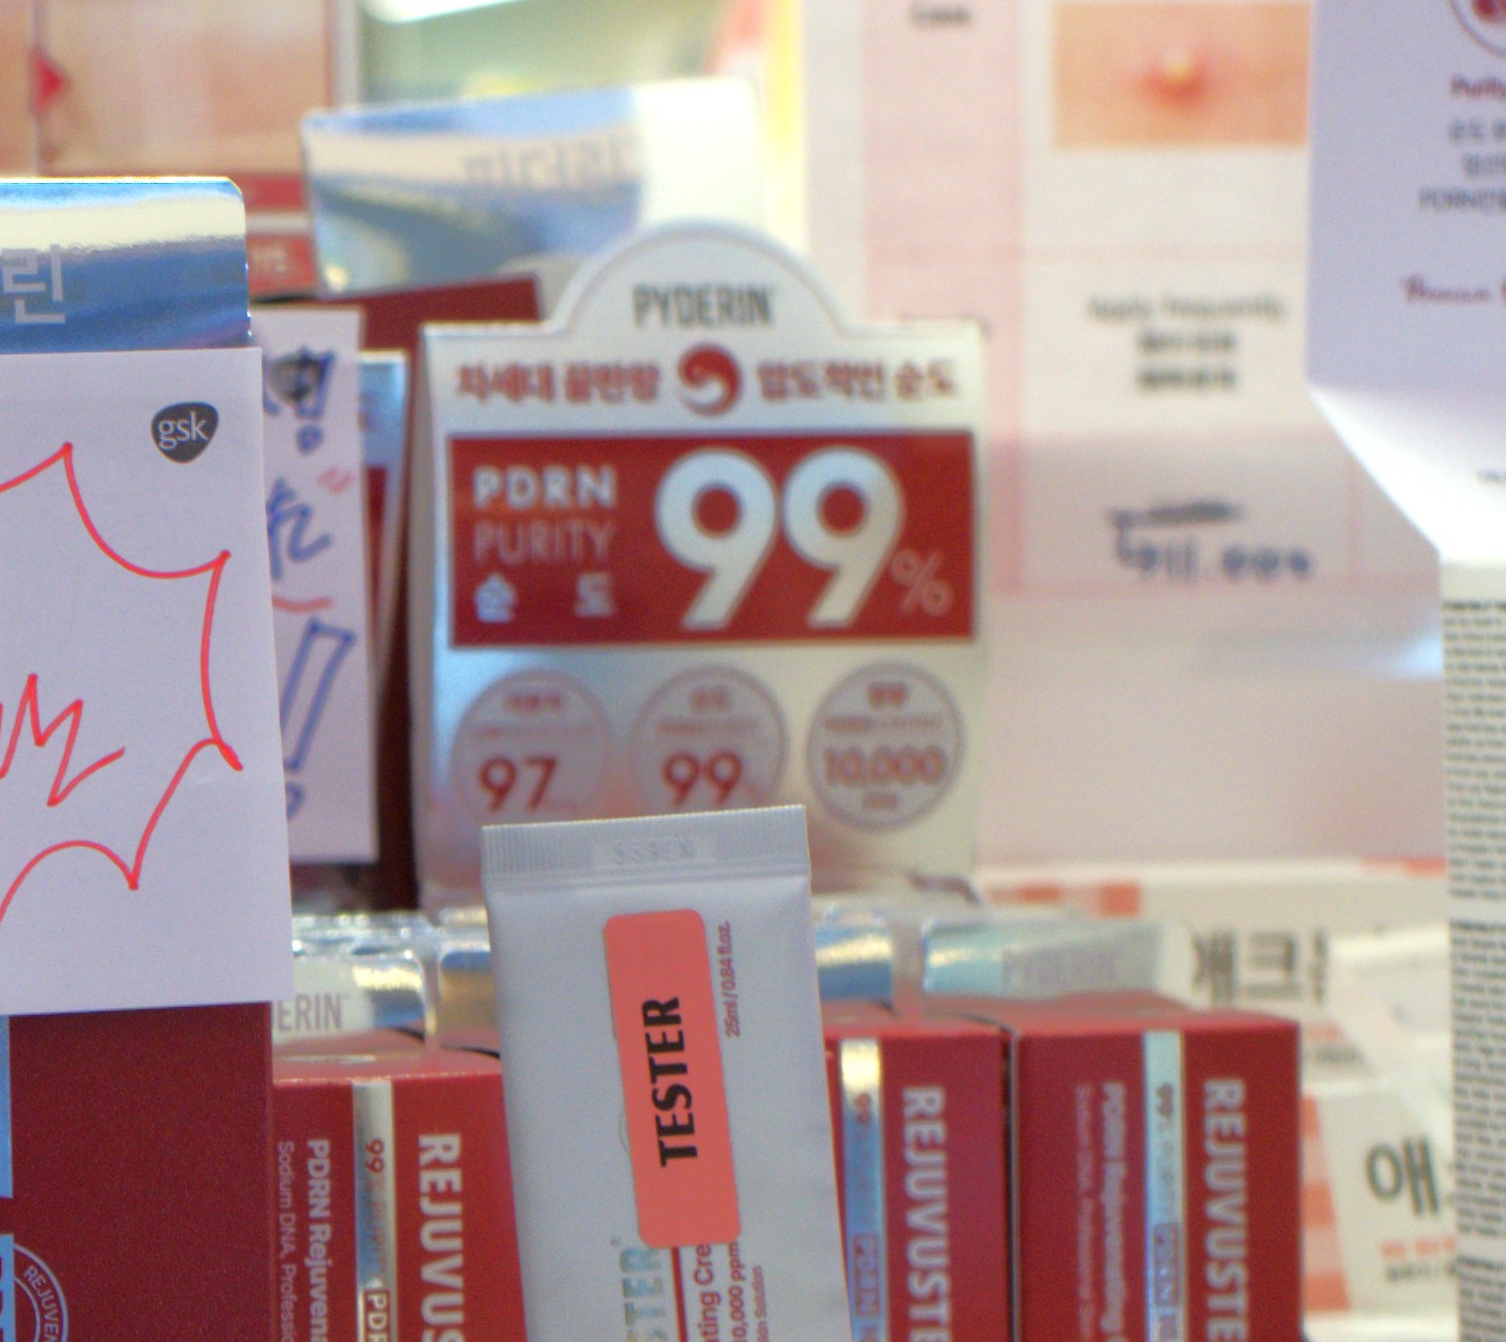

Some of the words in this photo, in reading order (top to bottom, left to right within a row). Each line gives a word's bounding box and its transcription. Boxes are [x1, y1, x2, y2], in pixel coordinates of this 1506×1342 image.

[632, 283, 773, 327] PYDERIN
[156, 408, 210, 451] gsk
[472, 464, 618, 510] PDRN
[472, 519, 616, 565] PURITY
[653, 444, 955, 632] 99%
[476, 755, 560, 815] 97
[274, 991, 343, 1032] ERIN
[640, 995, 699, 1168] TESTER
[306, 1138, 331, 1220] PDRN
[693, 1243, 714, 1287] Cre
